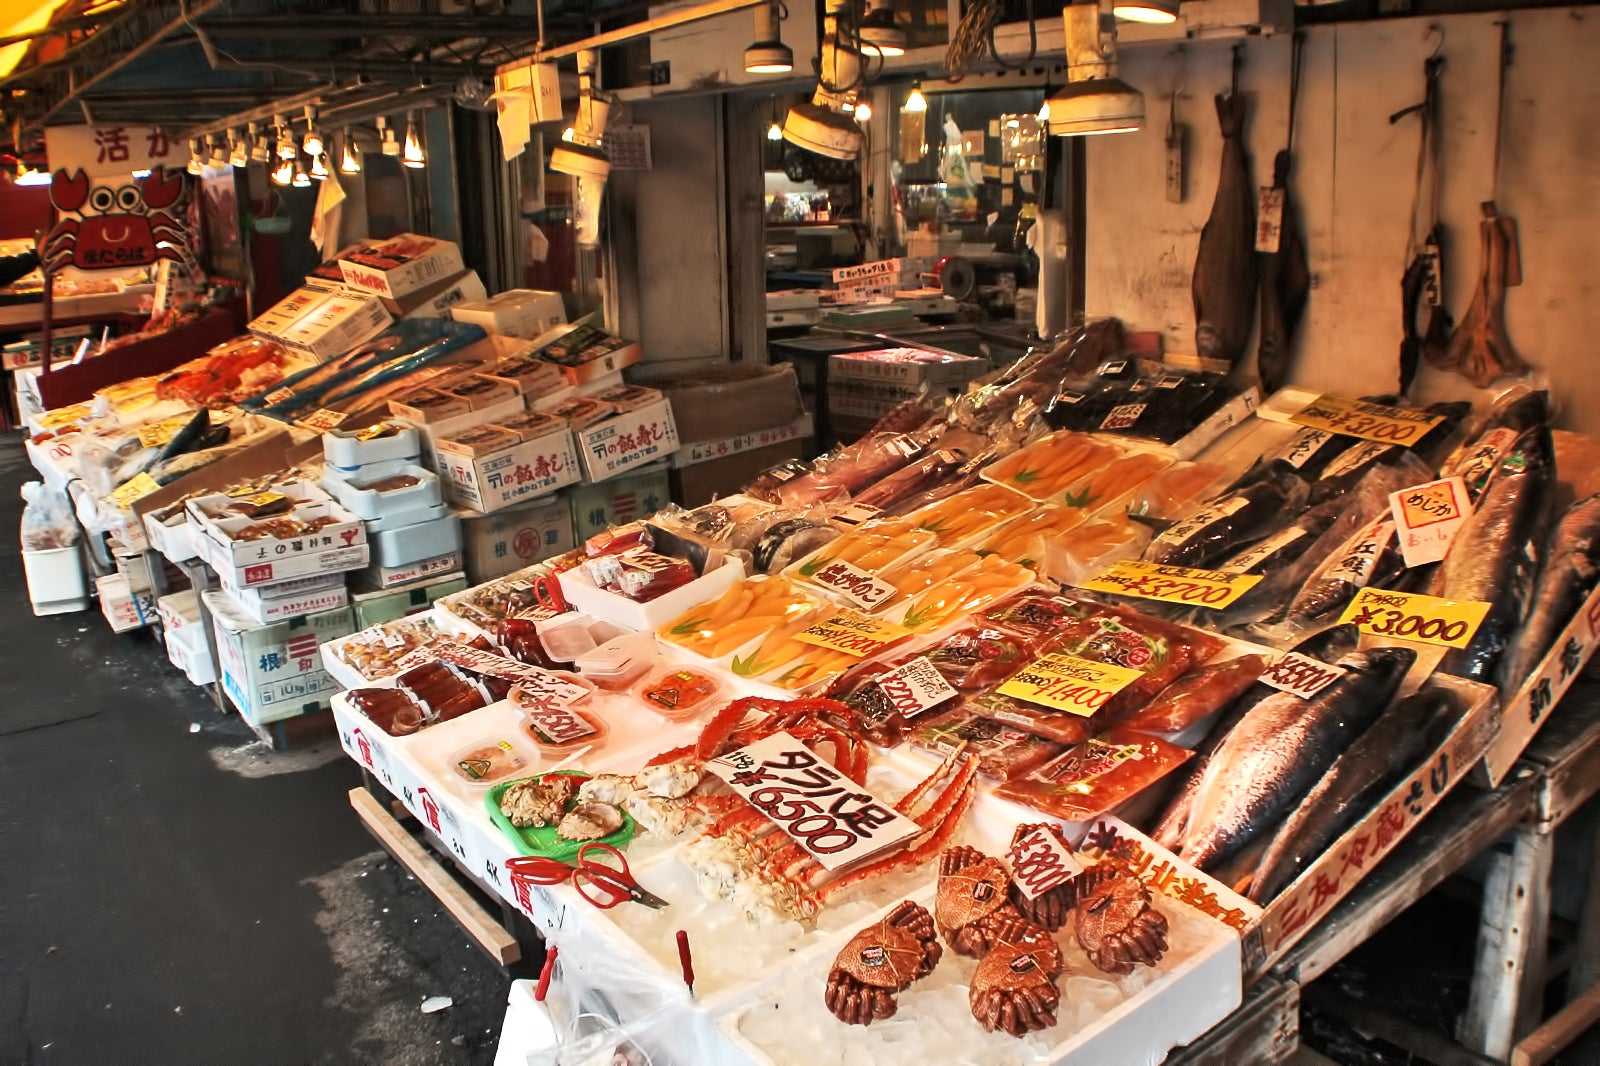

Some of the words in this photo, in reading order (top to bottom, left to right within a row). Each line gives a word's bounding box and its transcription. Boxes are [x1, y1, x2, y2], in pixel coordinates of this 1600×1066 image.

[1407, 493, 1451, 517] めじか
[763, 750, 898, 839] タラバ足
[1403, 751, 1450, 818] さけ
